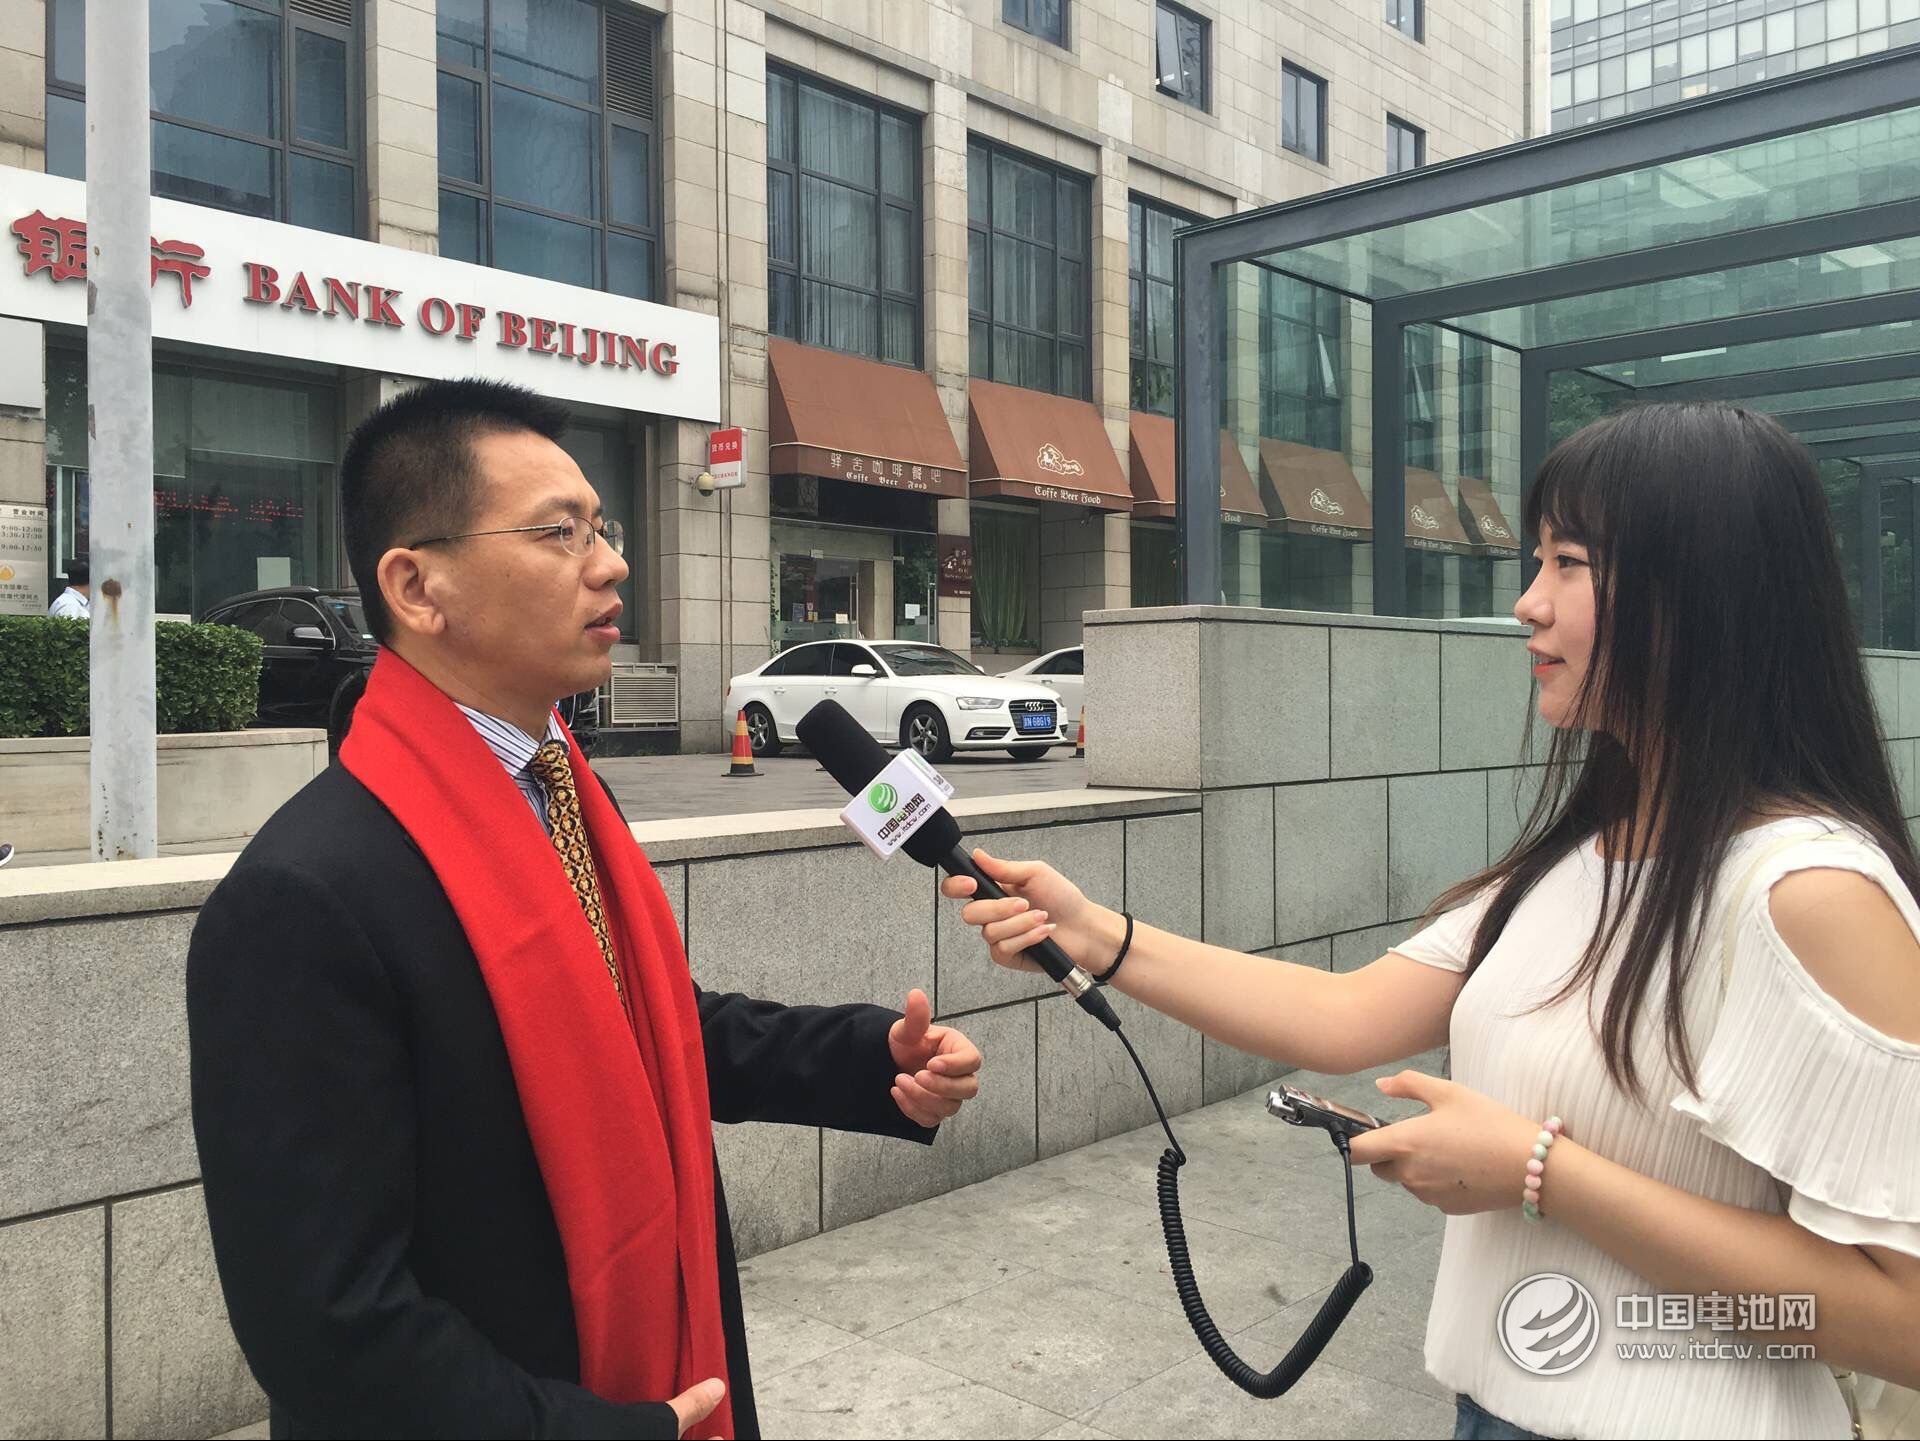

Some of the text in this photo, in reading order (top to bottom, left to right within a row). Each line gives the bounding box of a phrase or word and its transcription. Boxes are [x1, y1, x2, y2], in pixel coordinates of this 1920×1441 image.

[242, 261, 680, 377] BANK OF BEIJING
[877, 793, 925, 840] 中国电池网
